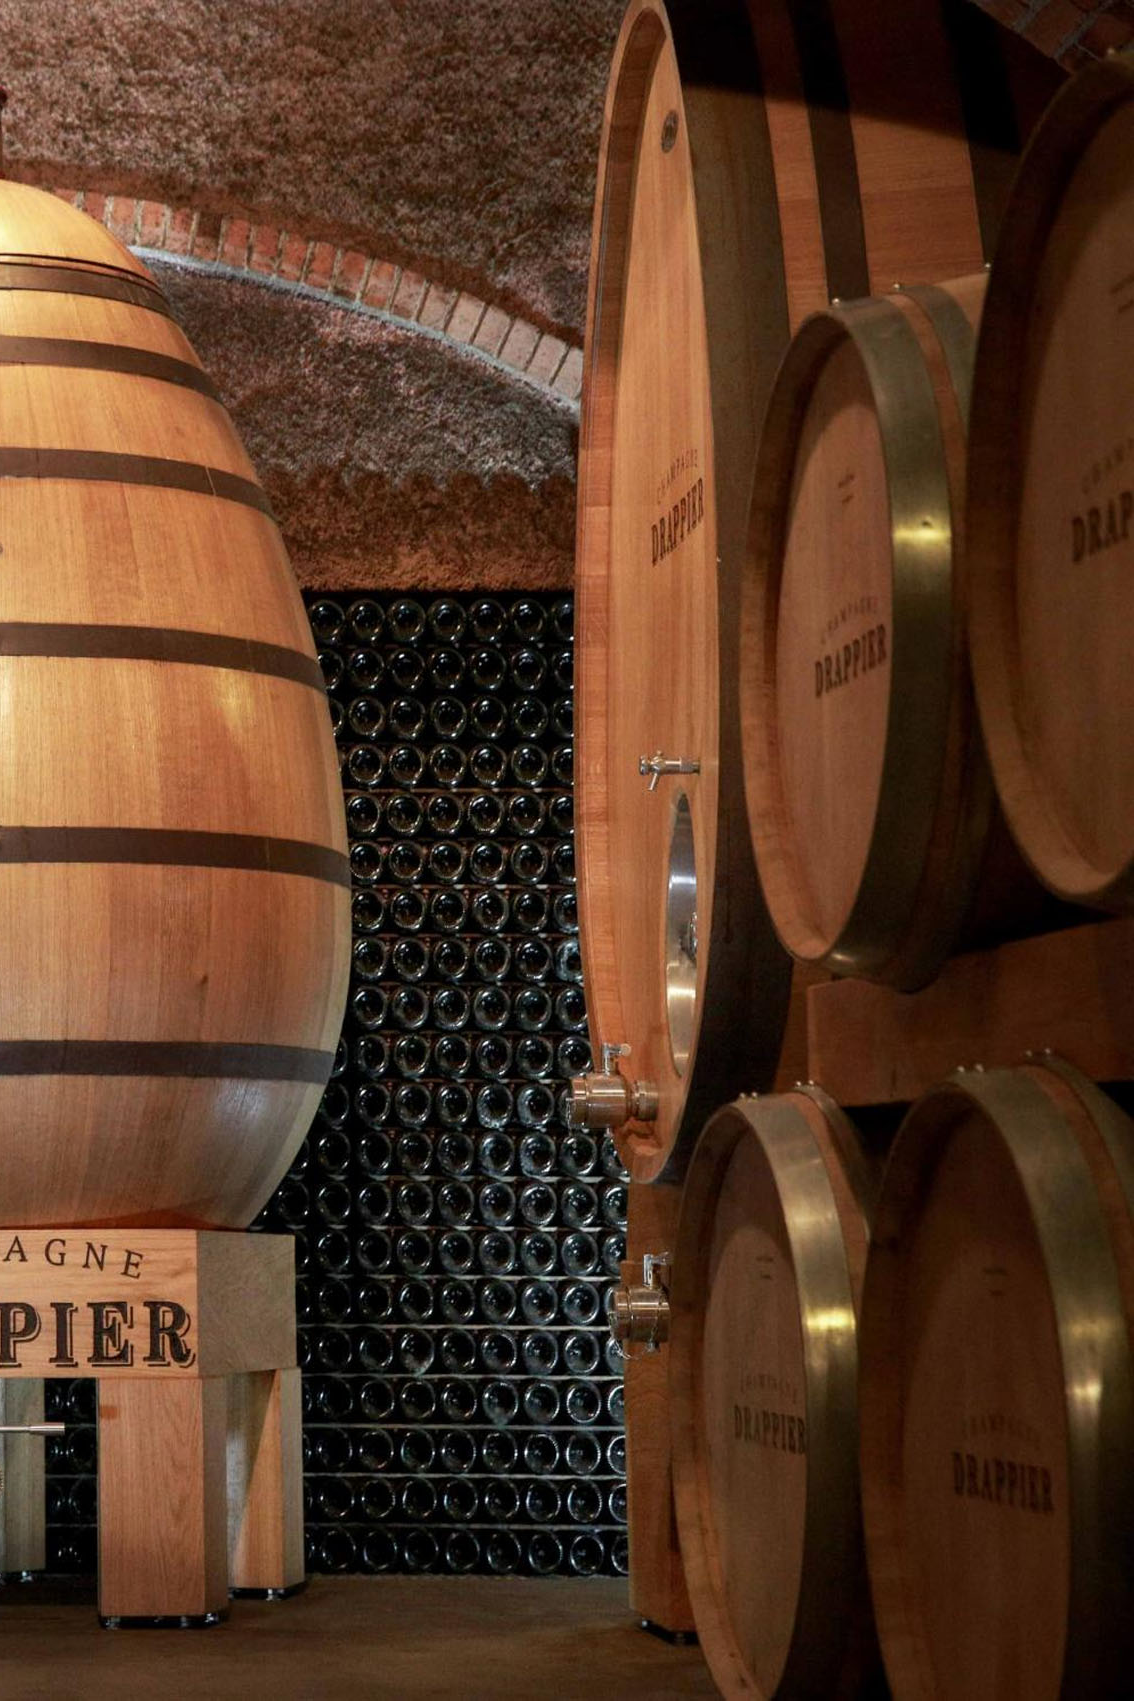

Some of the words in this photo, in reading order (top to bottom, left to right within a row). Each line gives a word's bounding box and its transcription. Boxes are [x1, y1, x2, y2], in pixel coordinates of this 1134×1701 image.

[651, 477, 704, 568] DRAPPIER
[815, 623, 887, 699] DRAPPIER
[734, 1403, 806, 1455] DRAPPIER
[952, 1450, 1054, 1516] DRAPPIER
